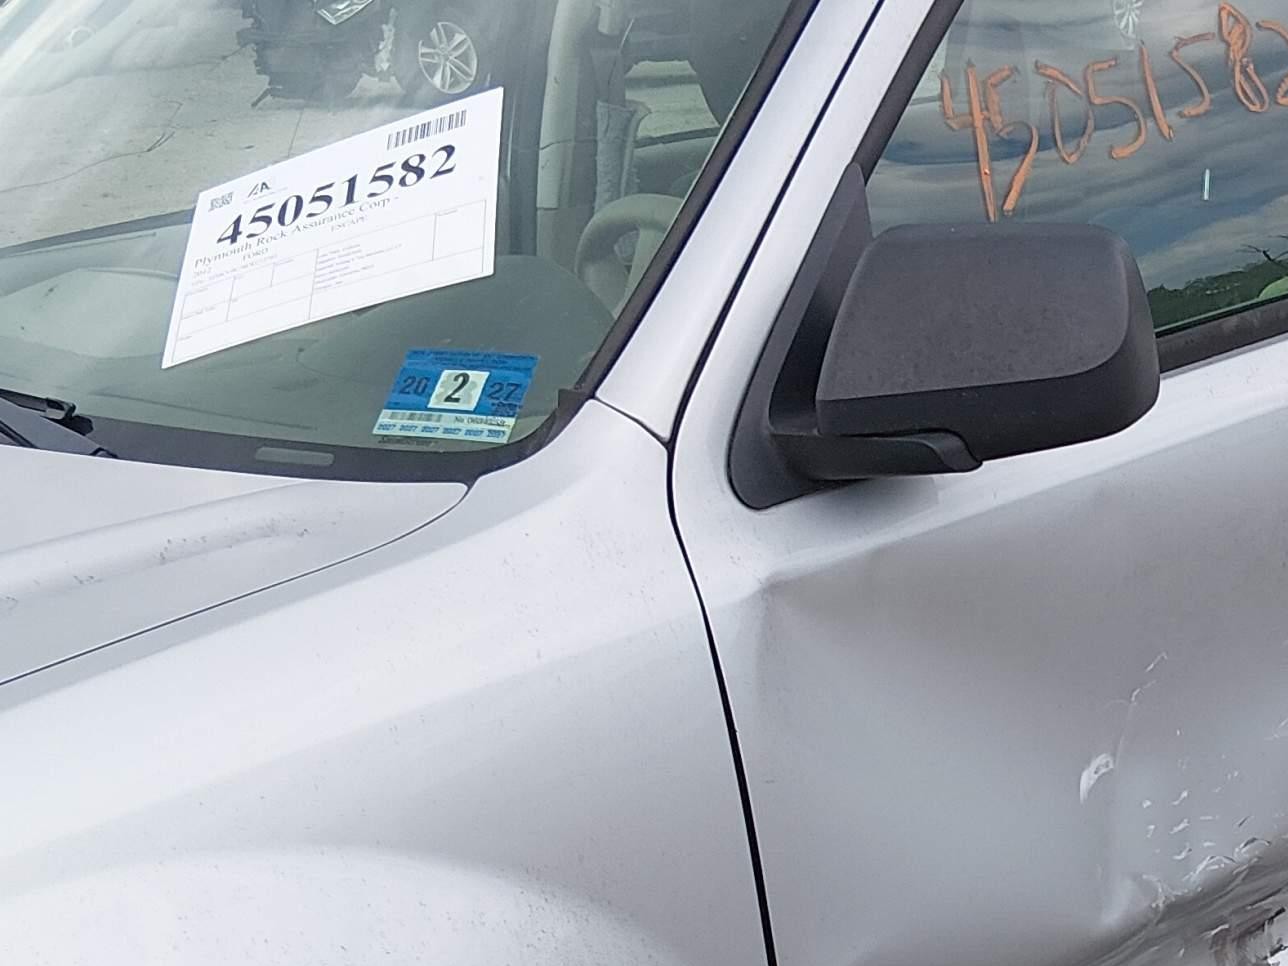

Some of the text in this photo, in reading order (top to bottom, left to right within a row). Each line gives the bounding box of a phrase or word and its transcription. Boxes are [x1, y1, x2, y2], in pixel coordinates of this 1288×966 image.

[216, 144, 457, 245] 45051582
[194, 241, 253, 269] Plymouth
[256, 229, 288, 247] Rock
[290, 207, 356, 235] Assurance
[359, 197, 391, 213] Corp
[399, 372, 522, 403] 20 2 27
